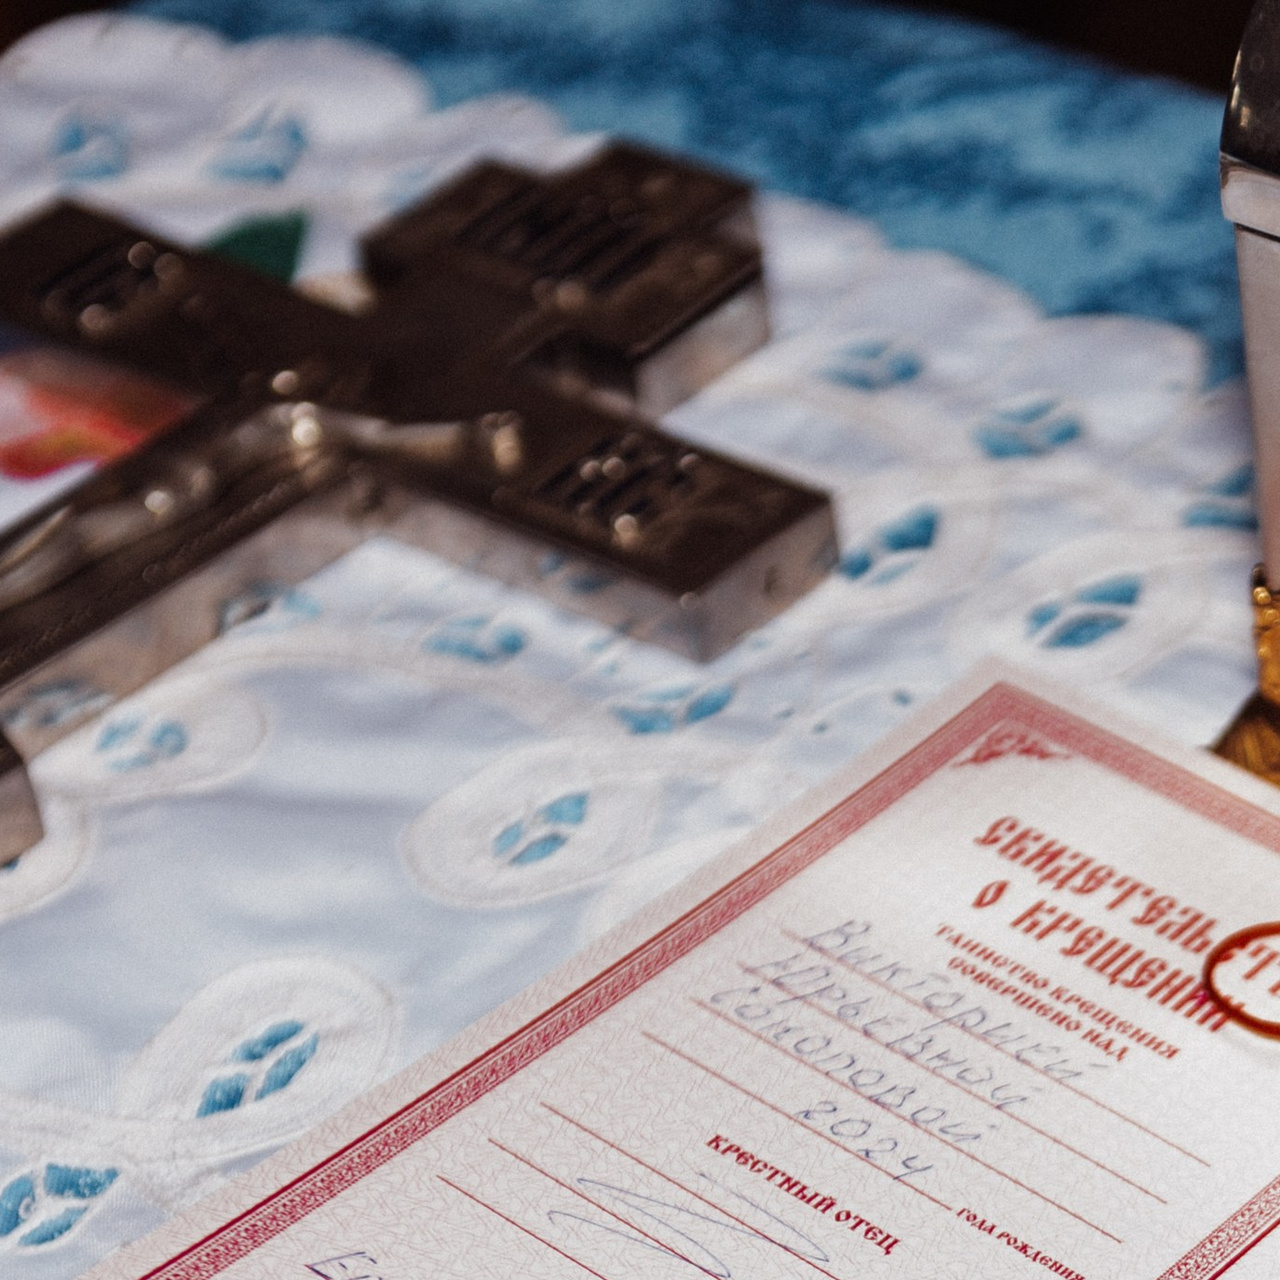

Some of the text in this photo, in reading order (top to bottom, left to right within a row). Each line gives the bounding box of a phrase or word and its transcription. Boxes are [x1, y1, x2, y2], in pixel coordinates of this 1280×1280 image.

[935, 922, 1182, 1061] ТАИНСТВО КРЕЩЕНИЯ
[948, 956, 1130, 1063] СОВЕРШЕНО НАД
[972, 879, 1245, 1033] О КРЕЩЕНИИ
[704, 1133, 902, 1256] КРЕСТНЫЙ ОТЕЦ
[796, 1100, 934, 1181] 2024
